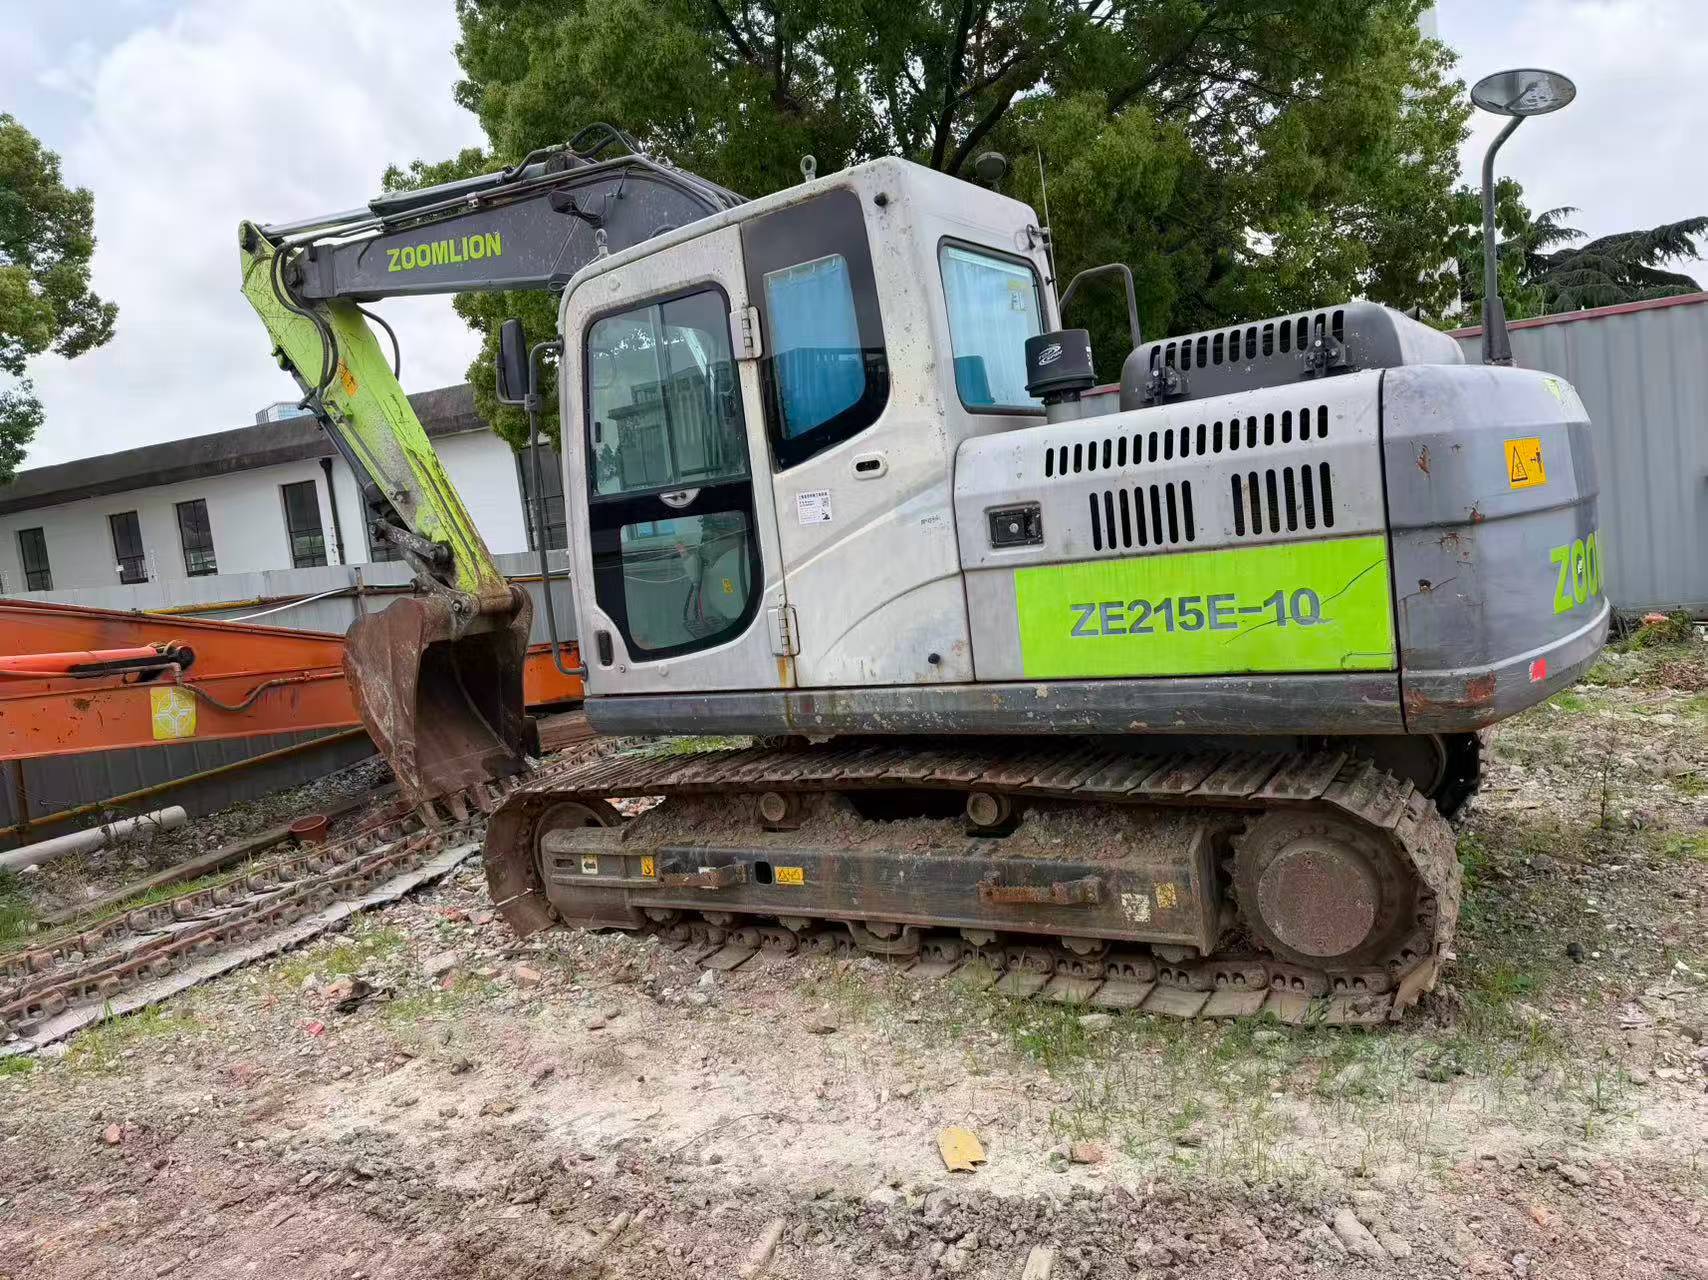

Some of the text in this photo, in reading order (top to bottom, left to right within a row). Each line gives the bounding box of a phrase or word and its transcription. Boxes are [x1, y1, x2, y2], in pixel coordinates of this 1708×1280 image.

[386, 232, 502, 272] ZOOMLION
[1550, 531, 1602, 615] ZOO
[1070, 588, 1321, 637] ZE215E-10
